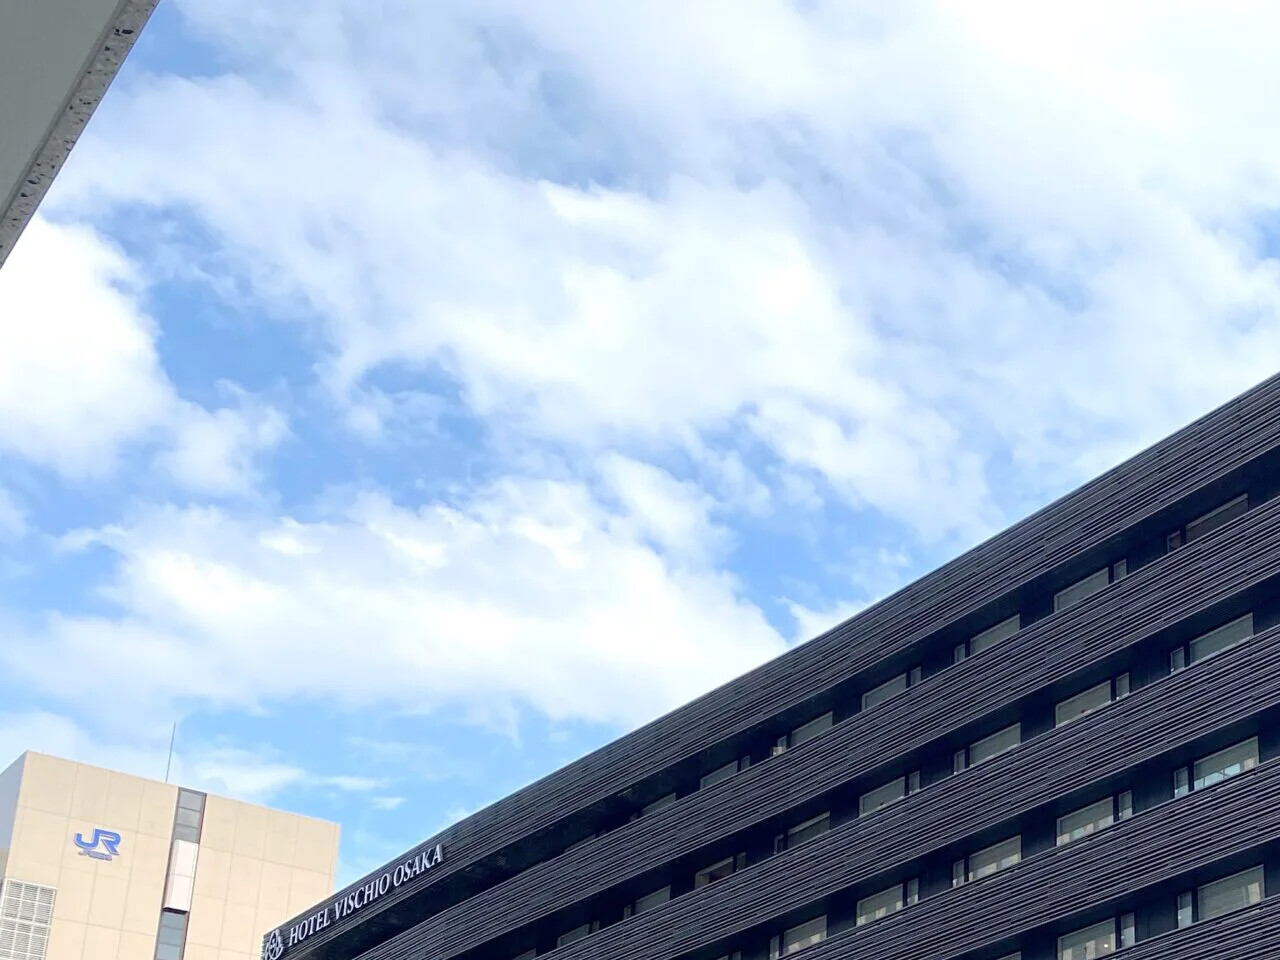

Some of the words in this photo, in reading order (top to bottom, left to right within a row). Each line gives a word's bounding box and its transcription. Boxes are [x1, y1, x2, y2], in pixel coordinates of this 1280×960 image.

[75, 828, 121, 855] JR
[288, 908, 331, 946] HOTEL
[334, 873, 390, 920] VISCHIO
[393, 844, 444, 886] OSAKA
